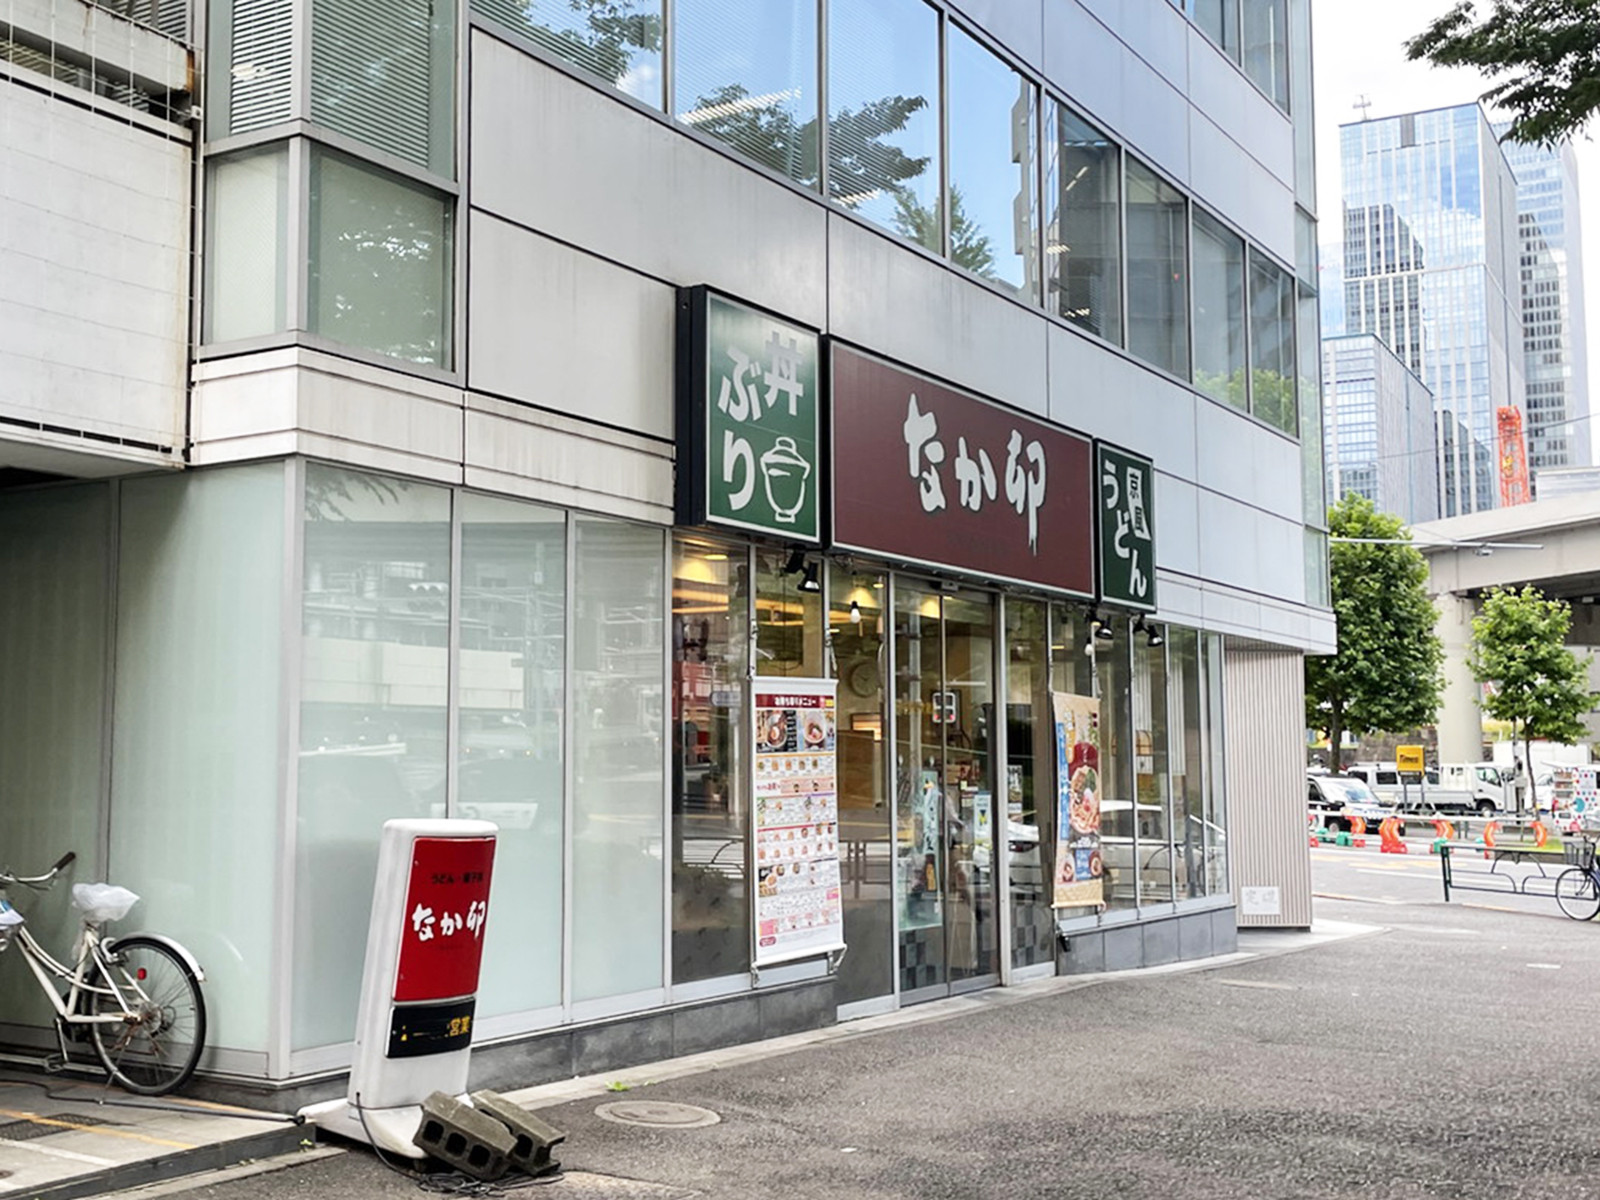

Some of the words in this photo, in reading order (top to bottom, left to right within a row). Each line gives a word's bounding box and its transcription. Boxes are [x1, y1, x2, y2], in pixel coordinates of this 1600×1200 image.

[717, 330, 804, 511] 丼ぶり
[903, 392, 1046, 557] なか卯
[1103, 459, 1148, 598] うどん
[412, 901, 486, 941] なか卯
